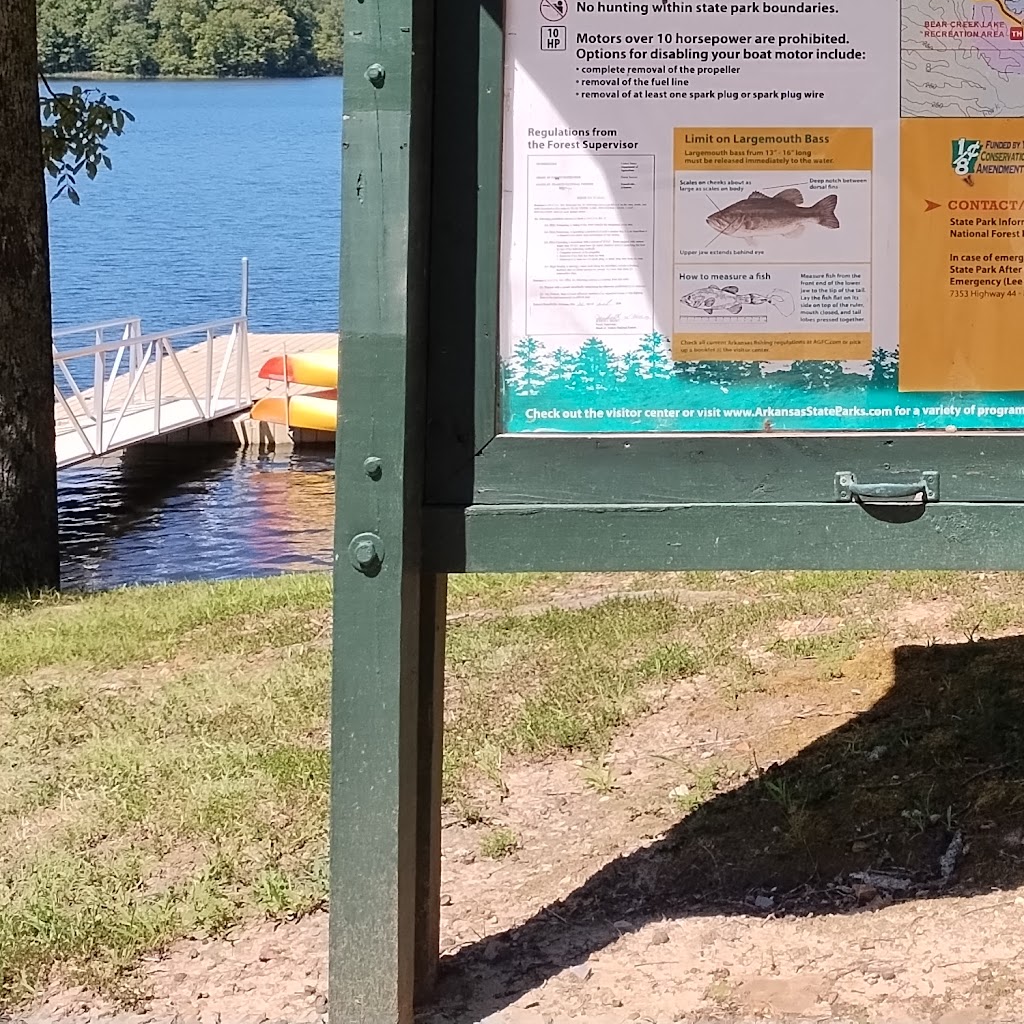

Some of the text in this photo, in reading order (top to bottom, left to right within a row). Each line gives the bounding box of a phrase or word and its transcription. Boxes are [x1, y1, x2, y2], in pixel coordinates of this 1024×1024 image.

[577, 1, 838, 15] No hunting within state park boundaries.
[548, 28, 559, 38] 10
[547, 38, 560, 48] HP
[577, 33, 622, 43] Motors
[657, 33, 672, 43] 10
[676, 33, 752, 46] horsepower
[755, 36, 775, 44] are
[779, 33, 849, 47] prohibited.
[576, 48, 865, 62] Options for disabling your boat motor include:
[581, 65, 740, 75] complete removal of the propeller
[528, 127, 617, 138] Regulations from
[528, 140, 544, 149] the
[583, 140, 638, 151] Supervisor
[685, 134, 713, 143] Limit
[734, 134, 802, 146] Largemouth
[805, 134, 829, 143] Bass
[950, 218, 974, 226] State
[976, 217, 997, 226] Park
[950, 253, 959, 262] In
[983, 253, 993, 262] of
[950, 278, 1001, 287] Emergency
[1003, 277, 1023, 286] (Lee
[525, 408, 561, 419] Check
[562, 410, 582, 418] out
[584, 409, 603, 418] the
[606, 408, 642, 418] visitor
[645, 409, 679, 418] center
[682, 410, 694, 418] or
[697, 408, 721, 418] visit
[723, 406, 892, 418] www.ArkansasStateParks.com
[894, 405, 911, 416] for
[913, 407, 920, 416] a
[922, 404, 961, 417] variety
[963, 404, 976, 415] of
